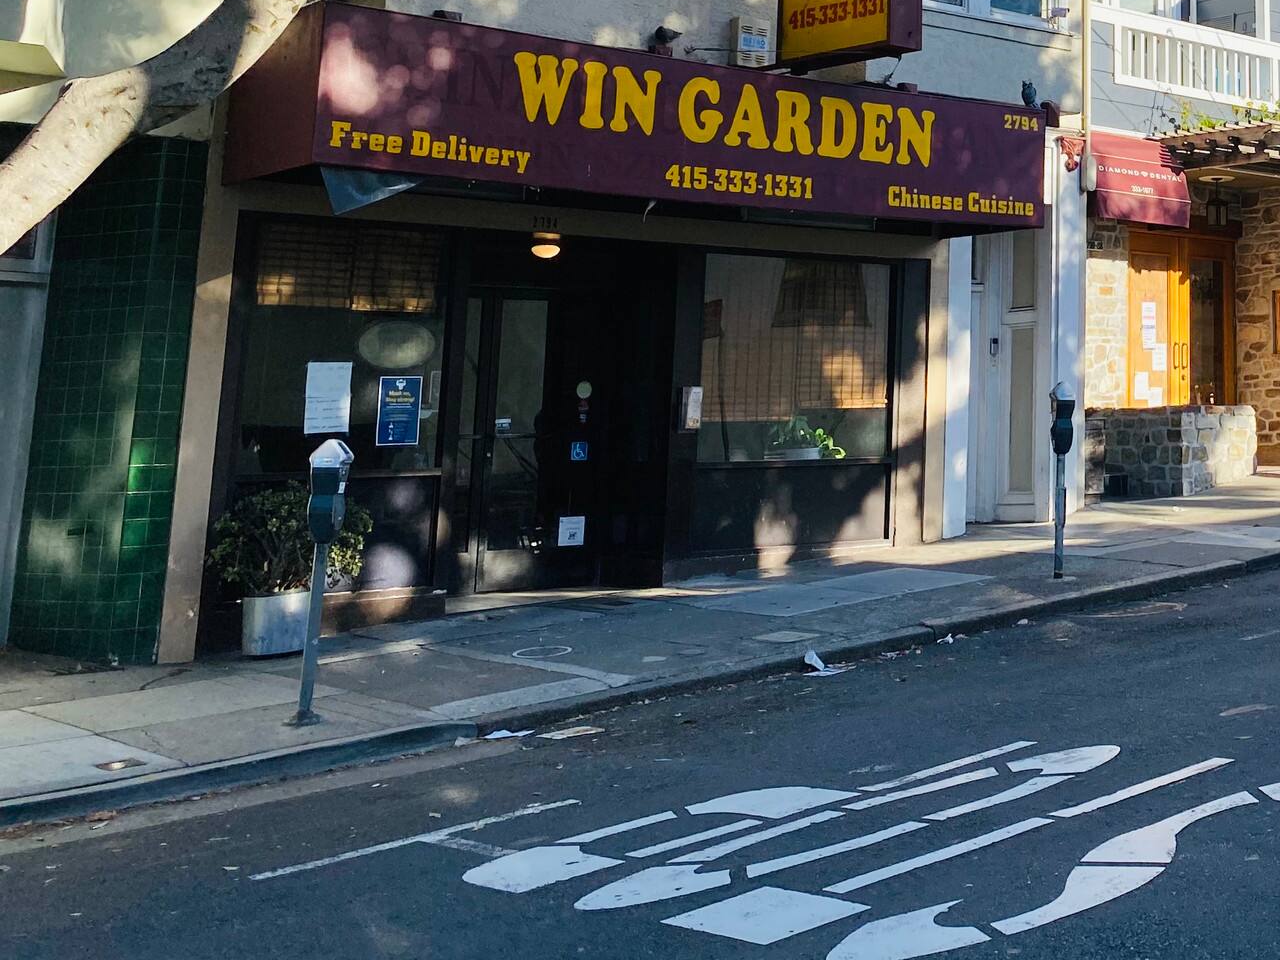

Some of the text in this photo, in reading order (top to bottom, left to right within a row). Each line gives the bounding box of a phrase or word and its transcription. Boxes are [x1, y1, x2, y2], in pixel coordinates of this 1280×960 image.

[513, 50, 663, 137] WIN
[677, 77, 936, 169] GARDEN
[1004, 113, 1039, 132] 2794
[329, 120, 531, 175] Free Delivery
[664, 163, 814, 201] 415-333-1331
[1098, 165, 1182, 183] DIAMOND DENTAL
[887, 185, 1035, 217] Chinese Cuisine
